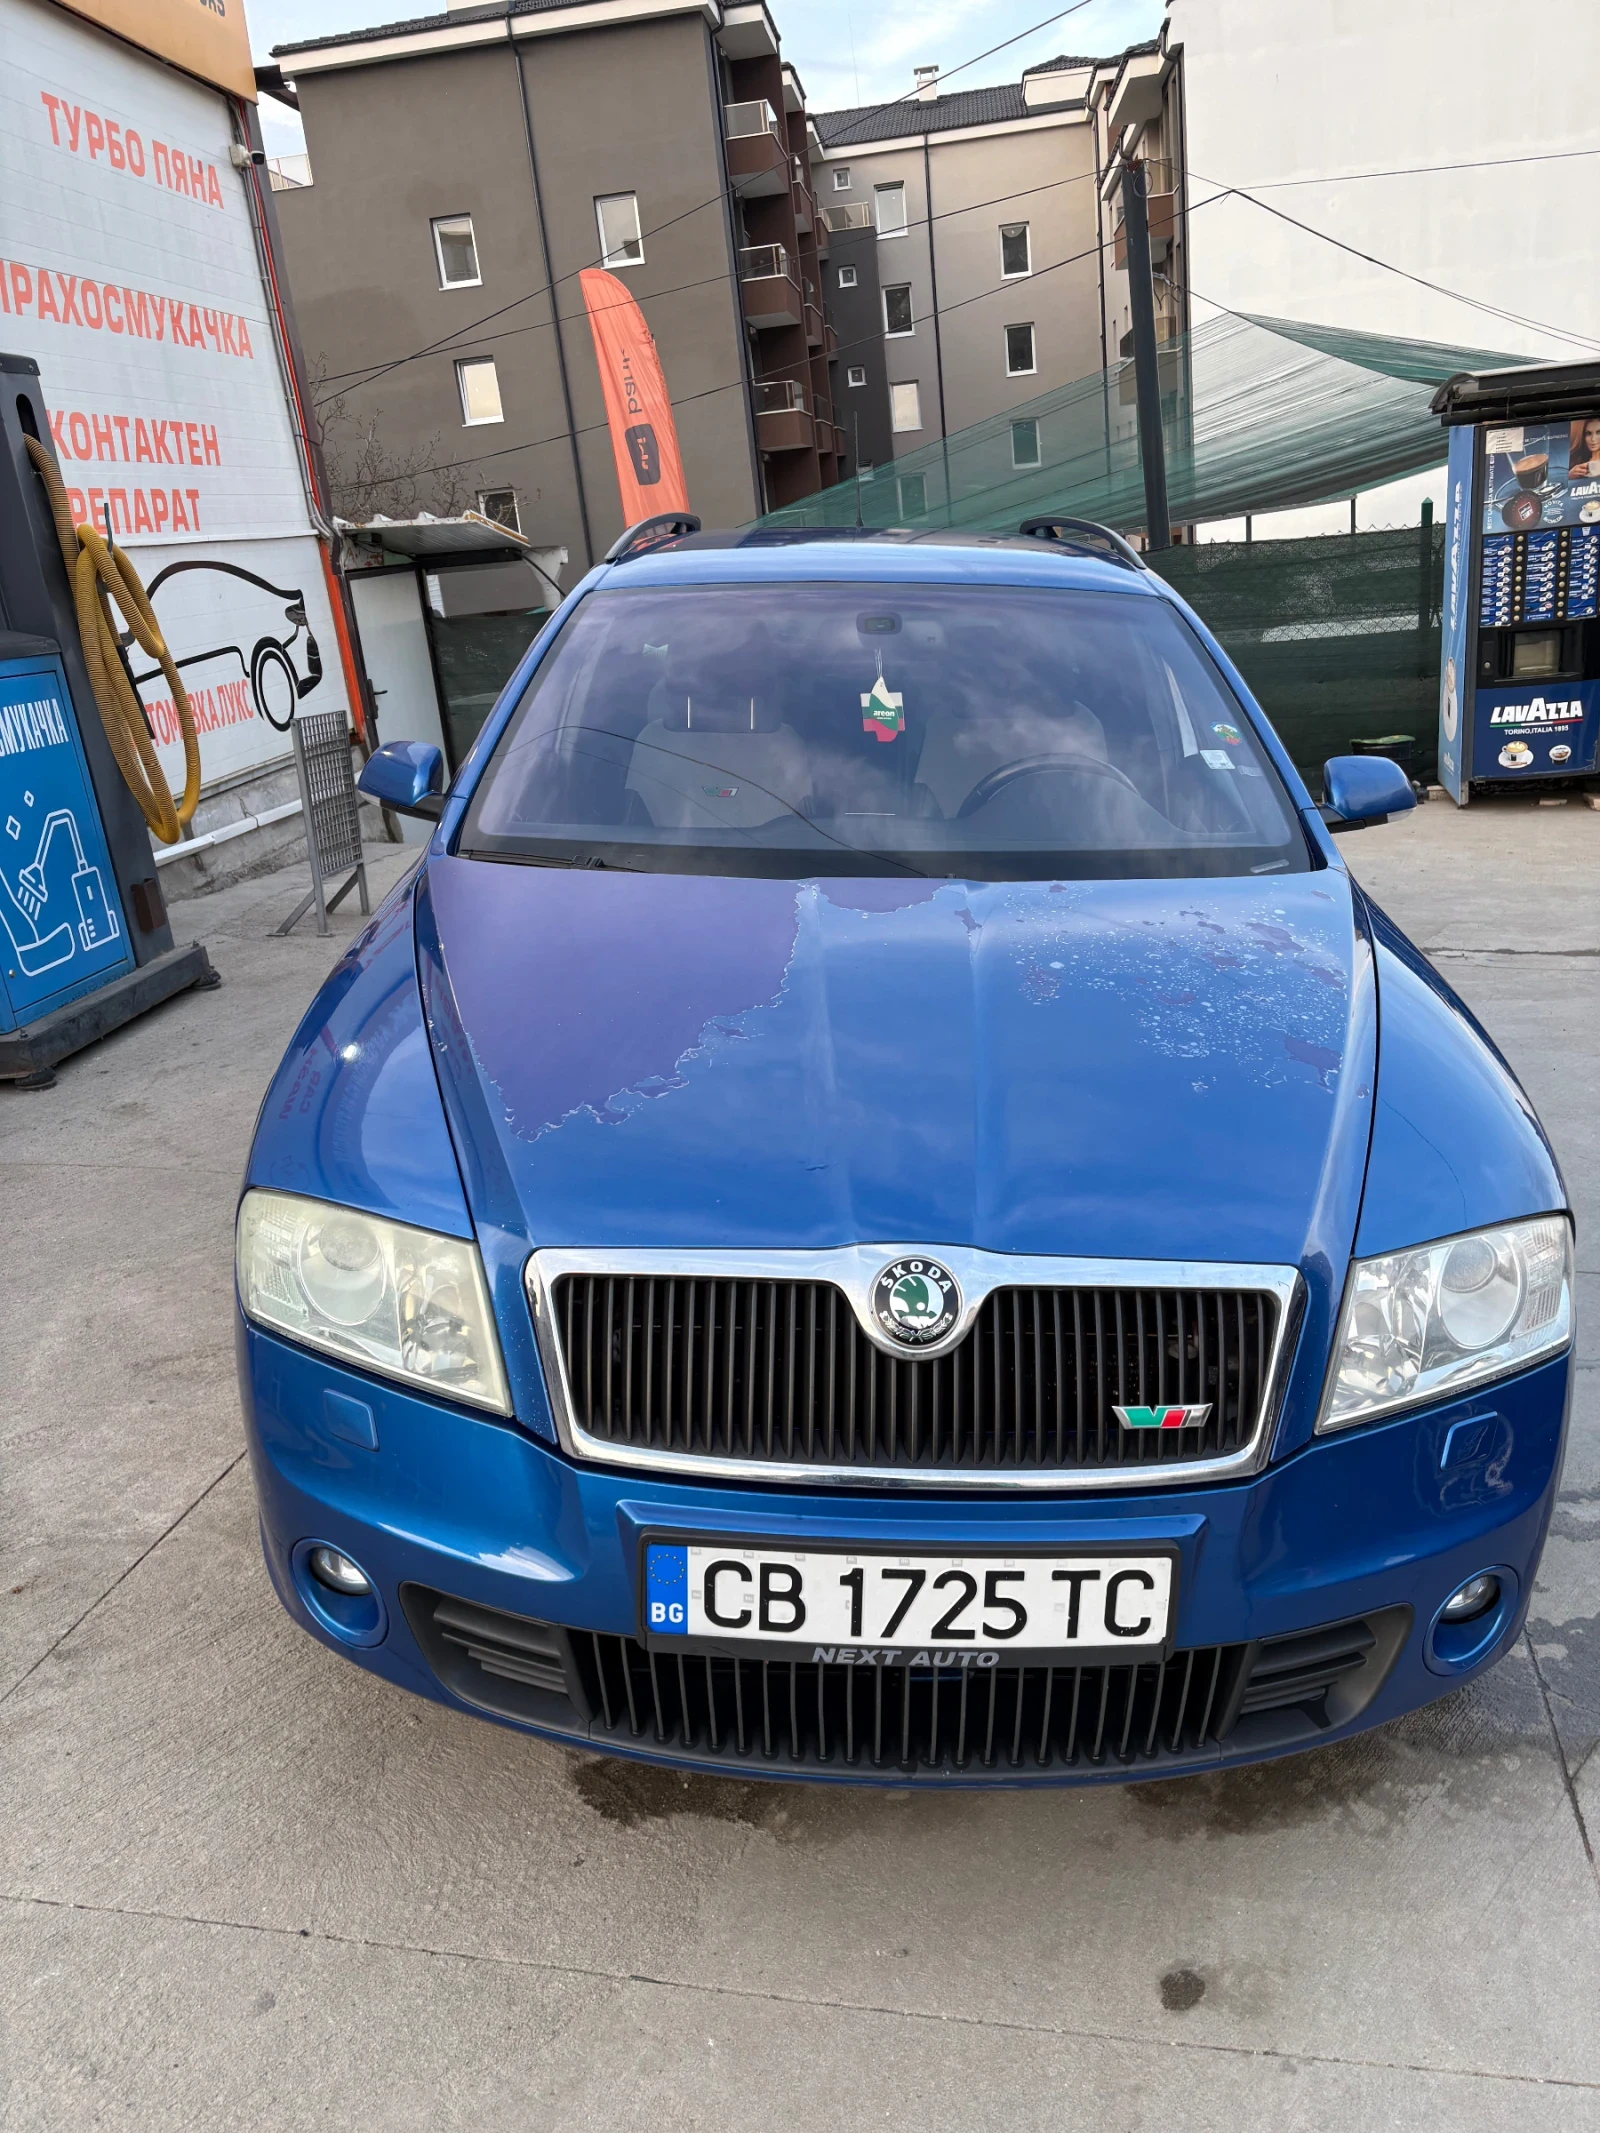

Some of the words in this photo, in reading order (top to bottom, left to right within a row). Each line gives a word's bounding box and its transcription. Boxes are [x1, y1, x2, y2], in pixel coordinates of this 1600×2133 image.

[41, 92, 146, 178] ТУРБО
[152, 140, 224, 209] ПЯНА
[46, 410, 221, 466] КОНТАКТЕН
[65, 487, 200, 535] РЕПАРАТ
[216, 679, 254, 727] ЛУКС
[1490, 697, 1583, 723] LAVAZZA
[651, 1602, 684, 1623] BG
[704, 1560, 806, 1633] CB
[839, 1567, 1028, 1640] 1725
[1051, 1569, 1155, 1638] TC
[811, 1646, 902, 1666] NEXT
[908, 1651, 1000, 1667] AUTO
